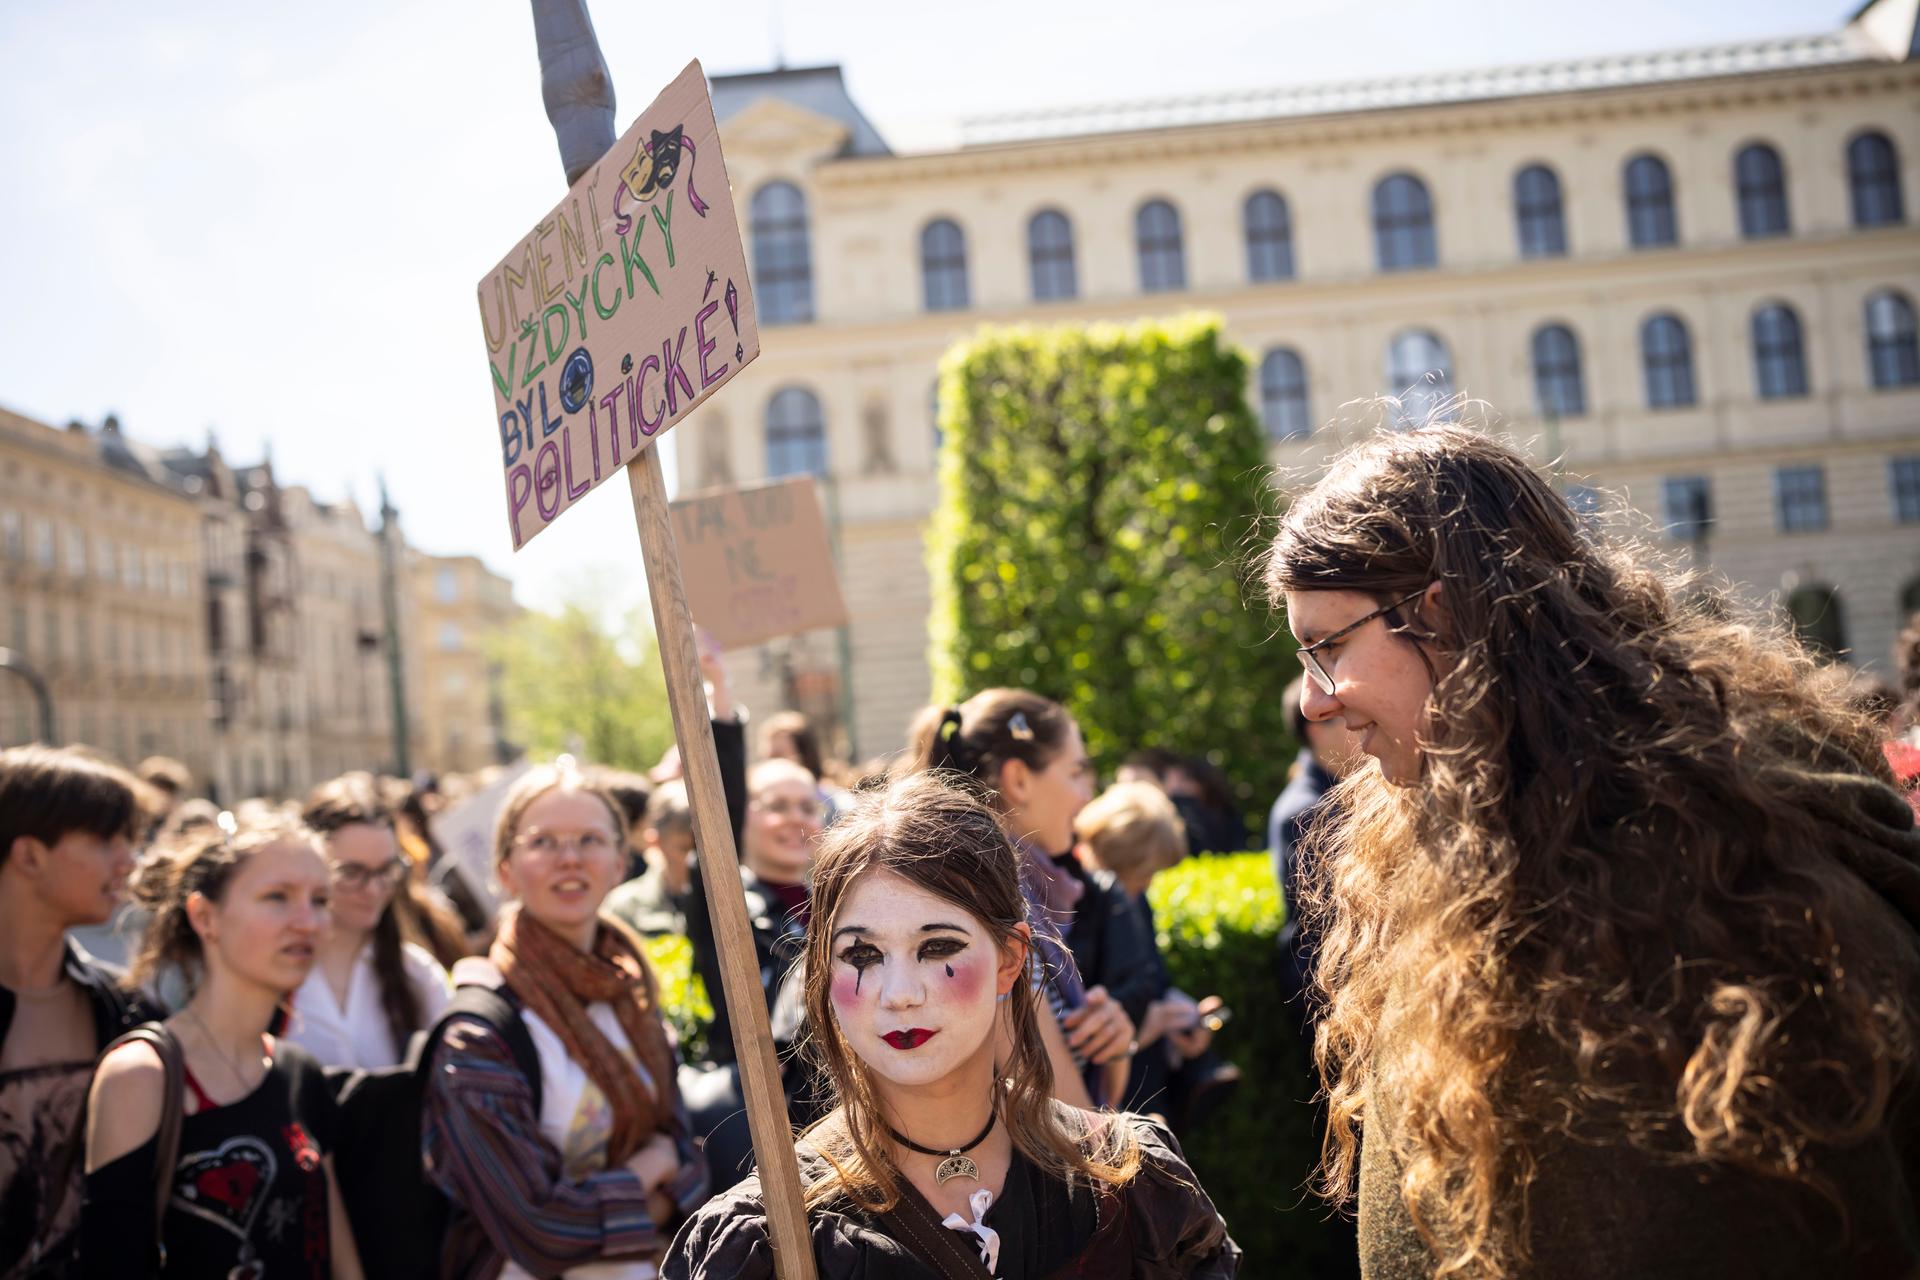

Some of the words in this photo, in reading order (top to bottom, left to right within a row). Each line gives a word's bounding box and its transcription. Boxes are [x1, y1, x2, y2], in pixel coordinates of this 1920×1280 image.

[478, 167, 604, 354] UMĚNÍ
[490, 189, 676, 403] VŽDYCKY
[501, 347, 594, 467] BYLO
[509, 266, 744, 546] POLITICKÉ!
